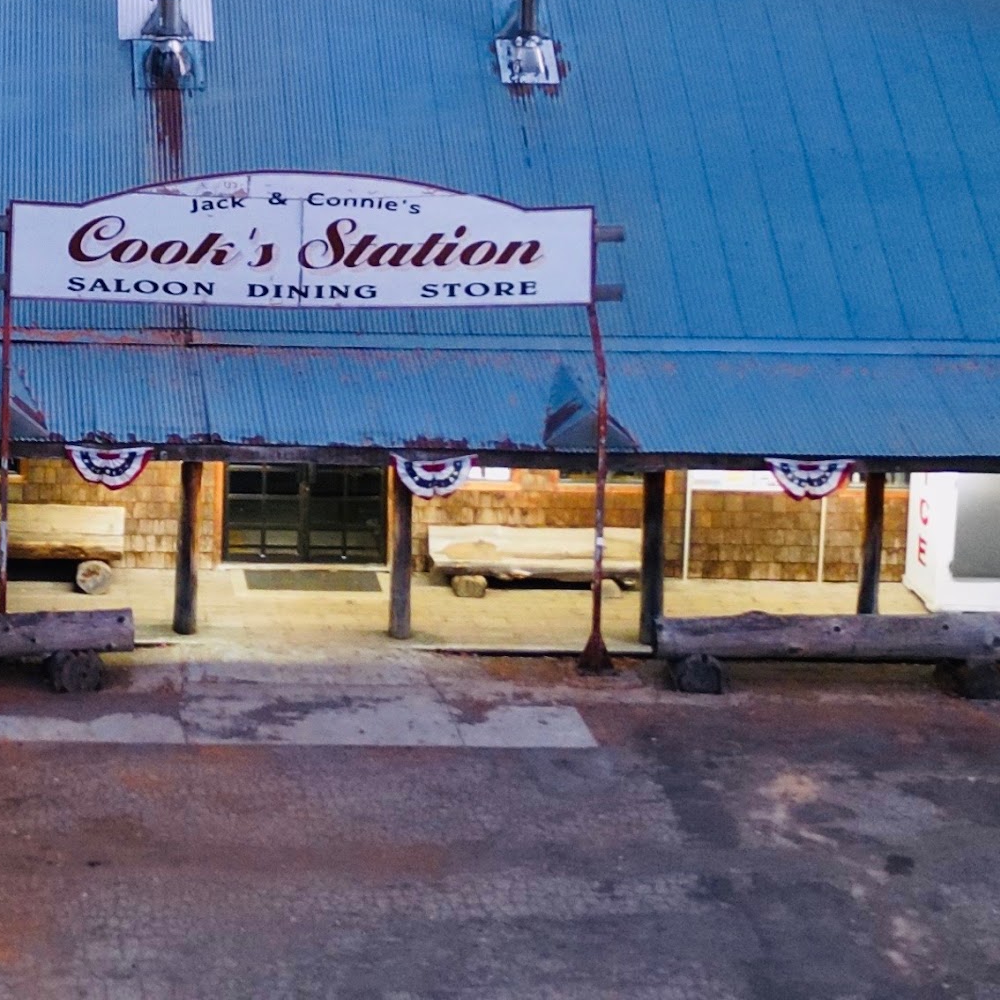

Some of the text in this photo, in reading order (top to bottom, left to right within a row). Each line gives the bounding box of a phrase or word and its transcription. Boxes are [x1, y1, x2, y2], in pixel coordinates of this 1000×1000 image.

[190, 192, 422, 215] Jack & Connie's
[67, 215, 545, 270] Cook's Station
[67, 276, 538, 300] SALOON DINING STORE
